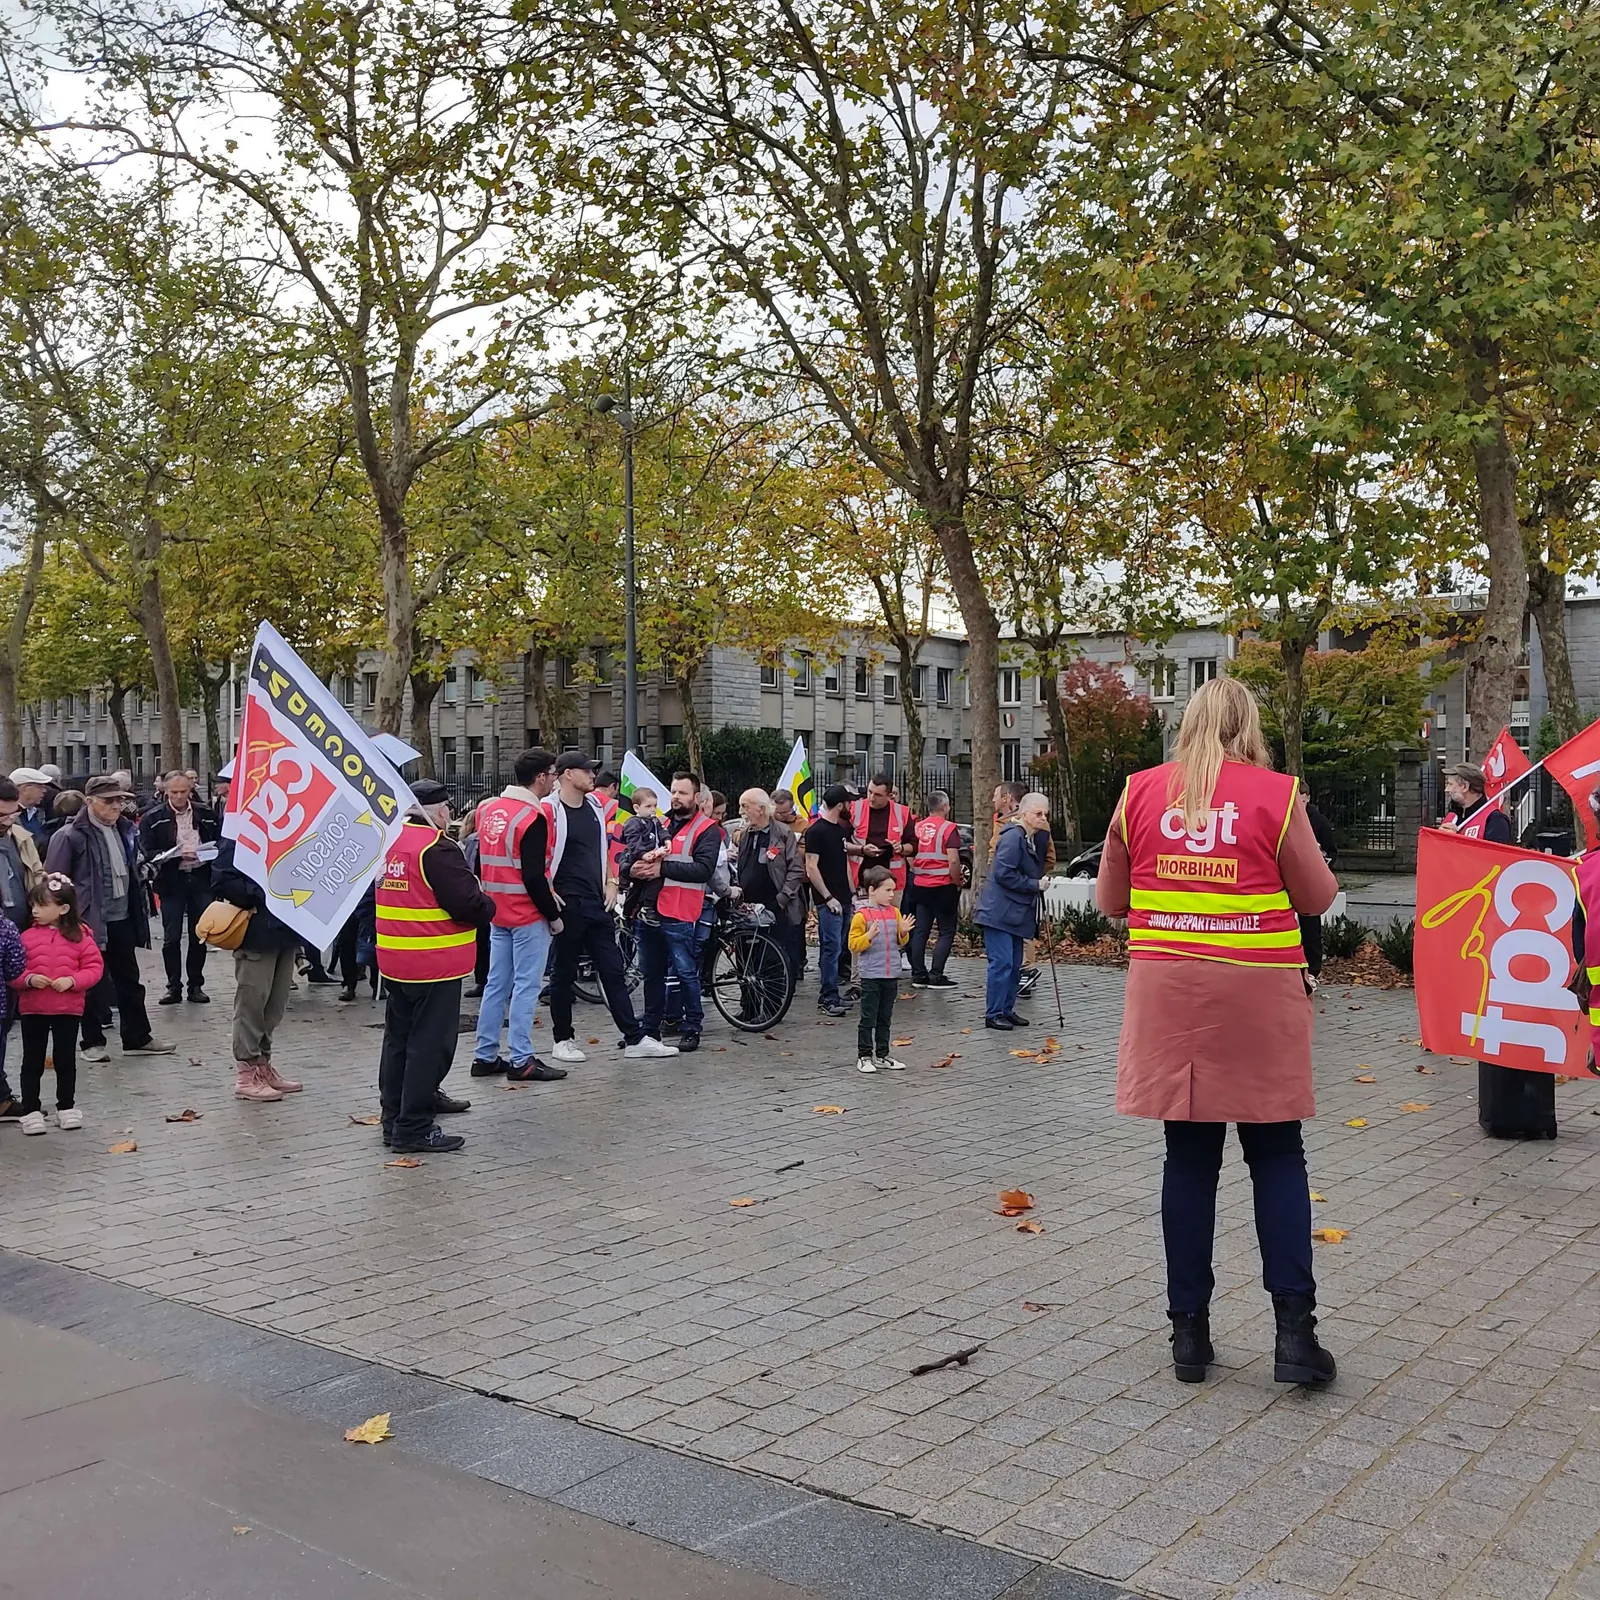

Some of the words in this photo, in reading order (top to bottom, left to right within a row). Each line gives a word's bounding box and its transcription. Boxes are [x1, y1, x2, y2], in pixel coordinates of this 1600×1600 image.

[387, 861, 405, 878] cgt
[1158, 859, 1235, 879] MORBIHAN
[384, 881, 407, 890] LORIENT
[1148, 914, 1178, 929] UNION
